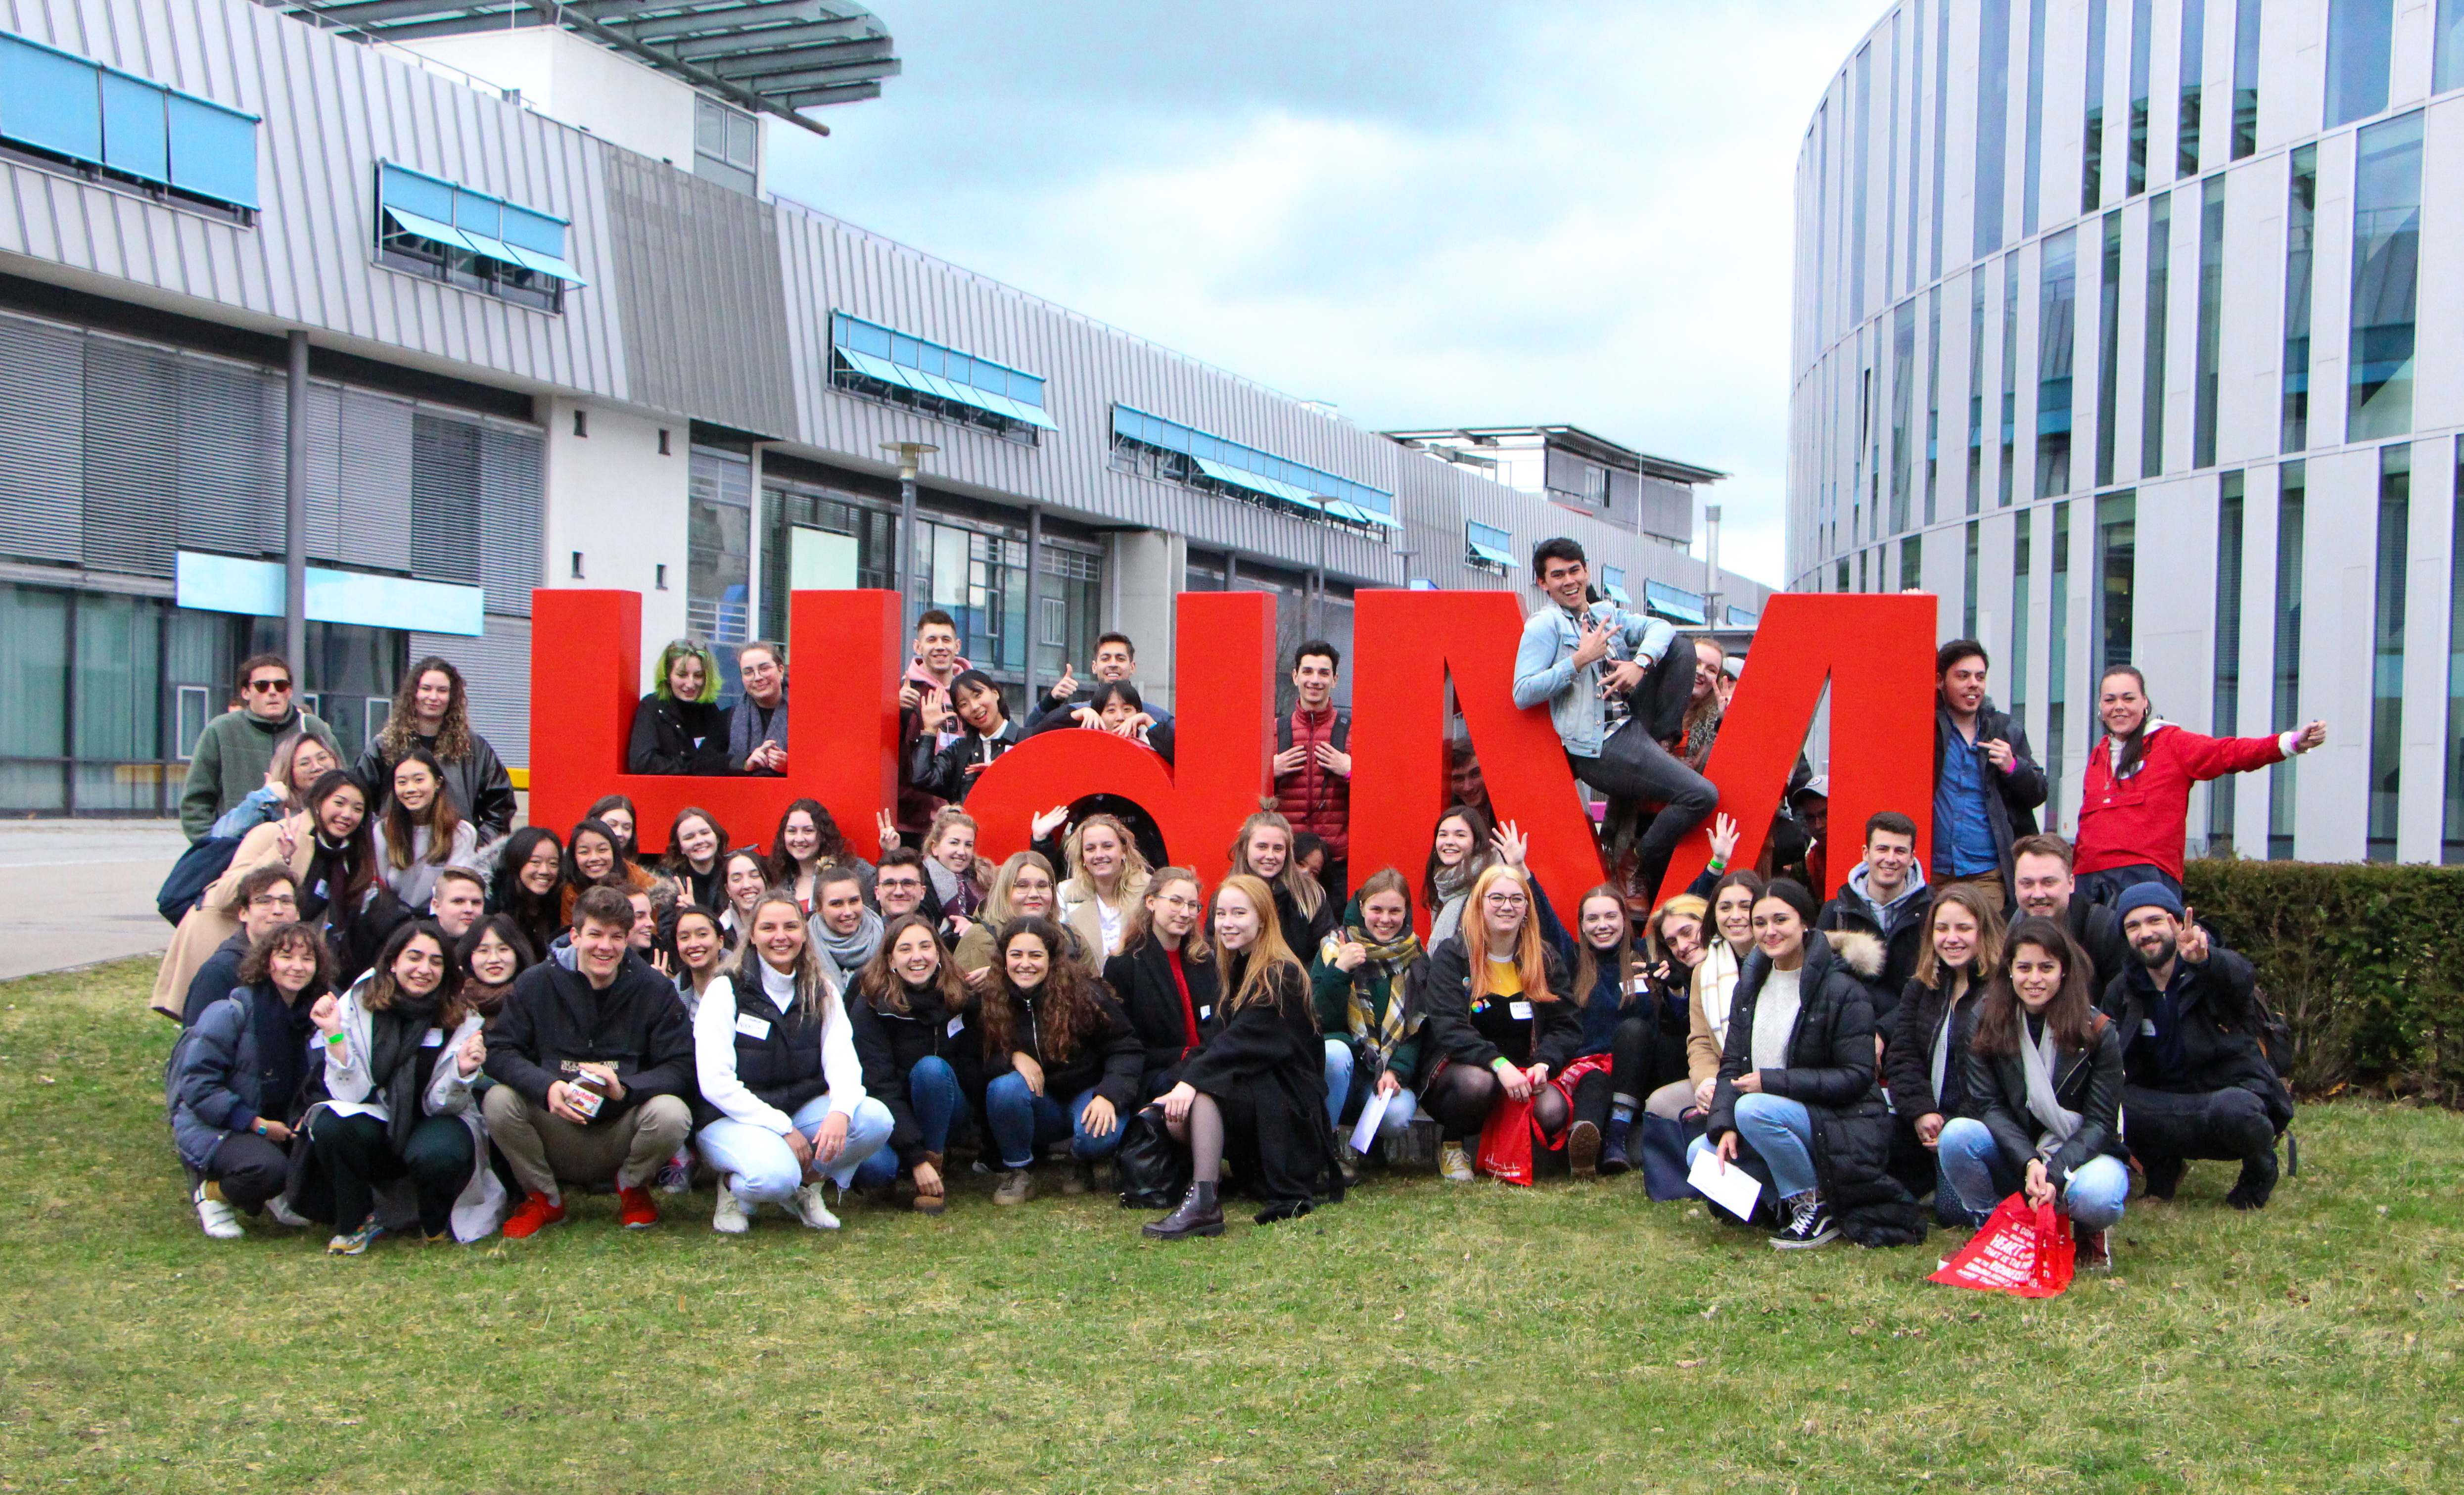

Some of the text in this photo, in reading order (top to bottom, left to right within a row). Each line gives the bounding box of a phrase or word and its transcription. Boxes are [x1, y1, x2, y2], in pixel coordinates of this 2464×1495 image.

[529, 589, 1937, 945] HdM
[572, 1089, 599, 1104] nutella
[1983, 1246, 2002, 1259] THAT
[2000, 1254, 2009, 1263] IS
[1990, 1233, 2027, 1257] HEART
[1988, 1260, 2024, 1281] RICHNESS
